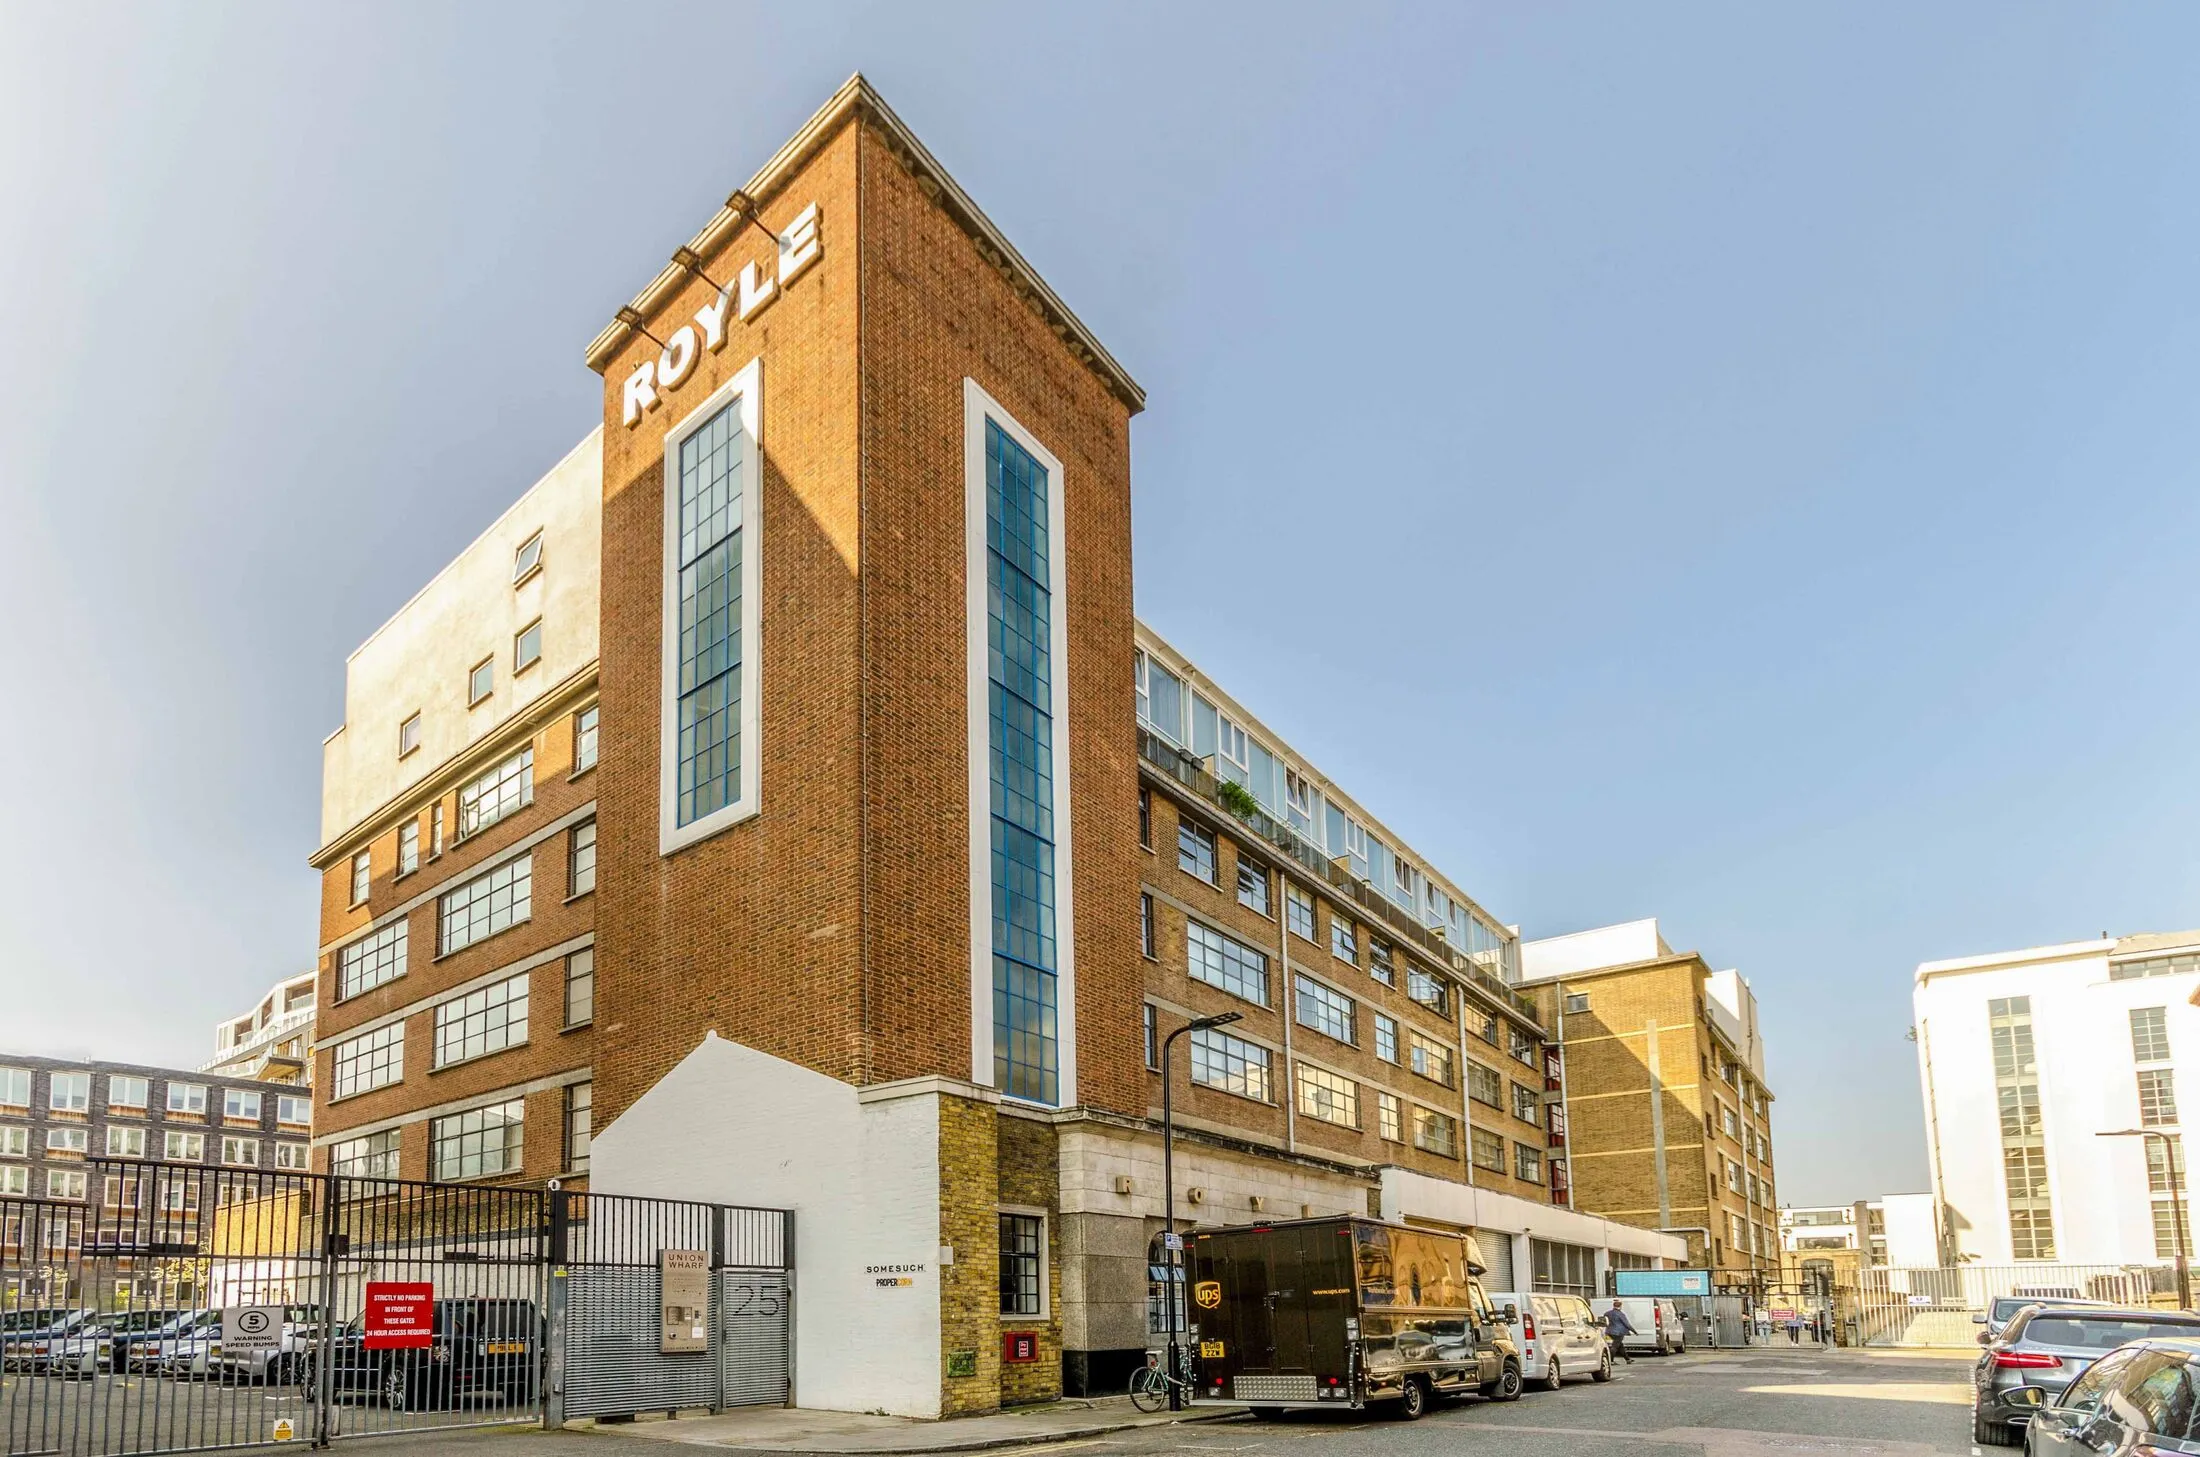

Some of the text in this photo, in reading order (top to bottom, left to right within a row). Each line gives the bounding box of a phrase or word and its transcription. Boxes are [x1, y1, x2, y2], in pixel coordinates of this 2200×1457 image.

[624, 201, 824, 430] ROYLE
[866, 1264, 924, 1273] SOMESUCH
[733, 1286, 779, 1316] 25
[249, 1315, 259, 1325] 5
